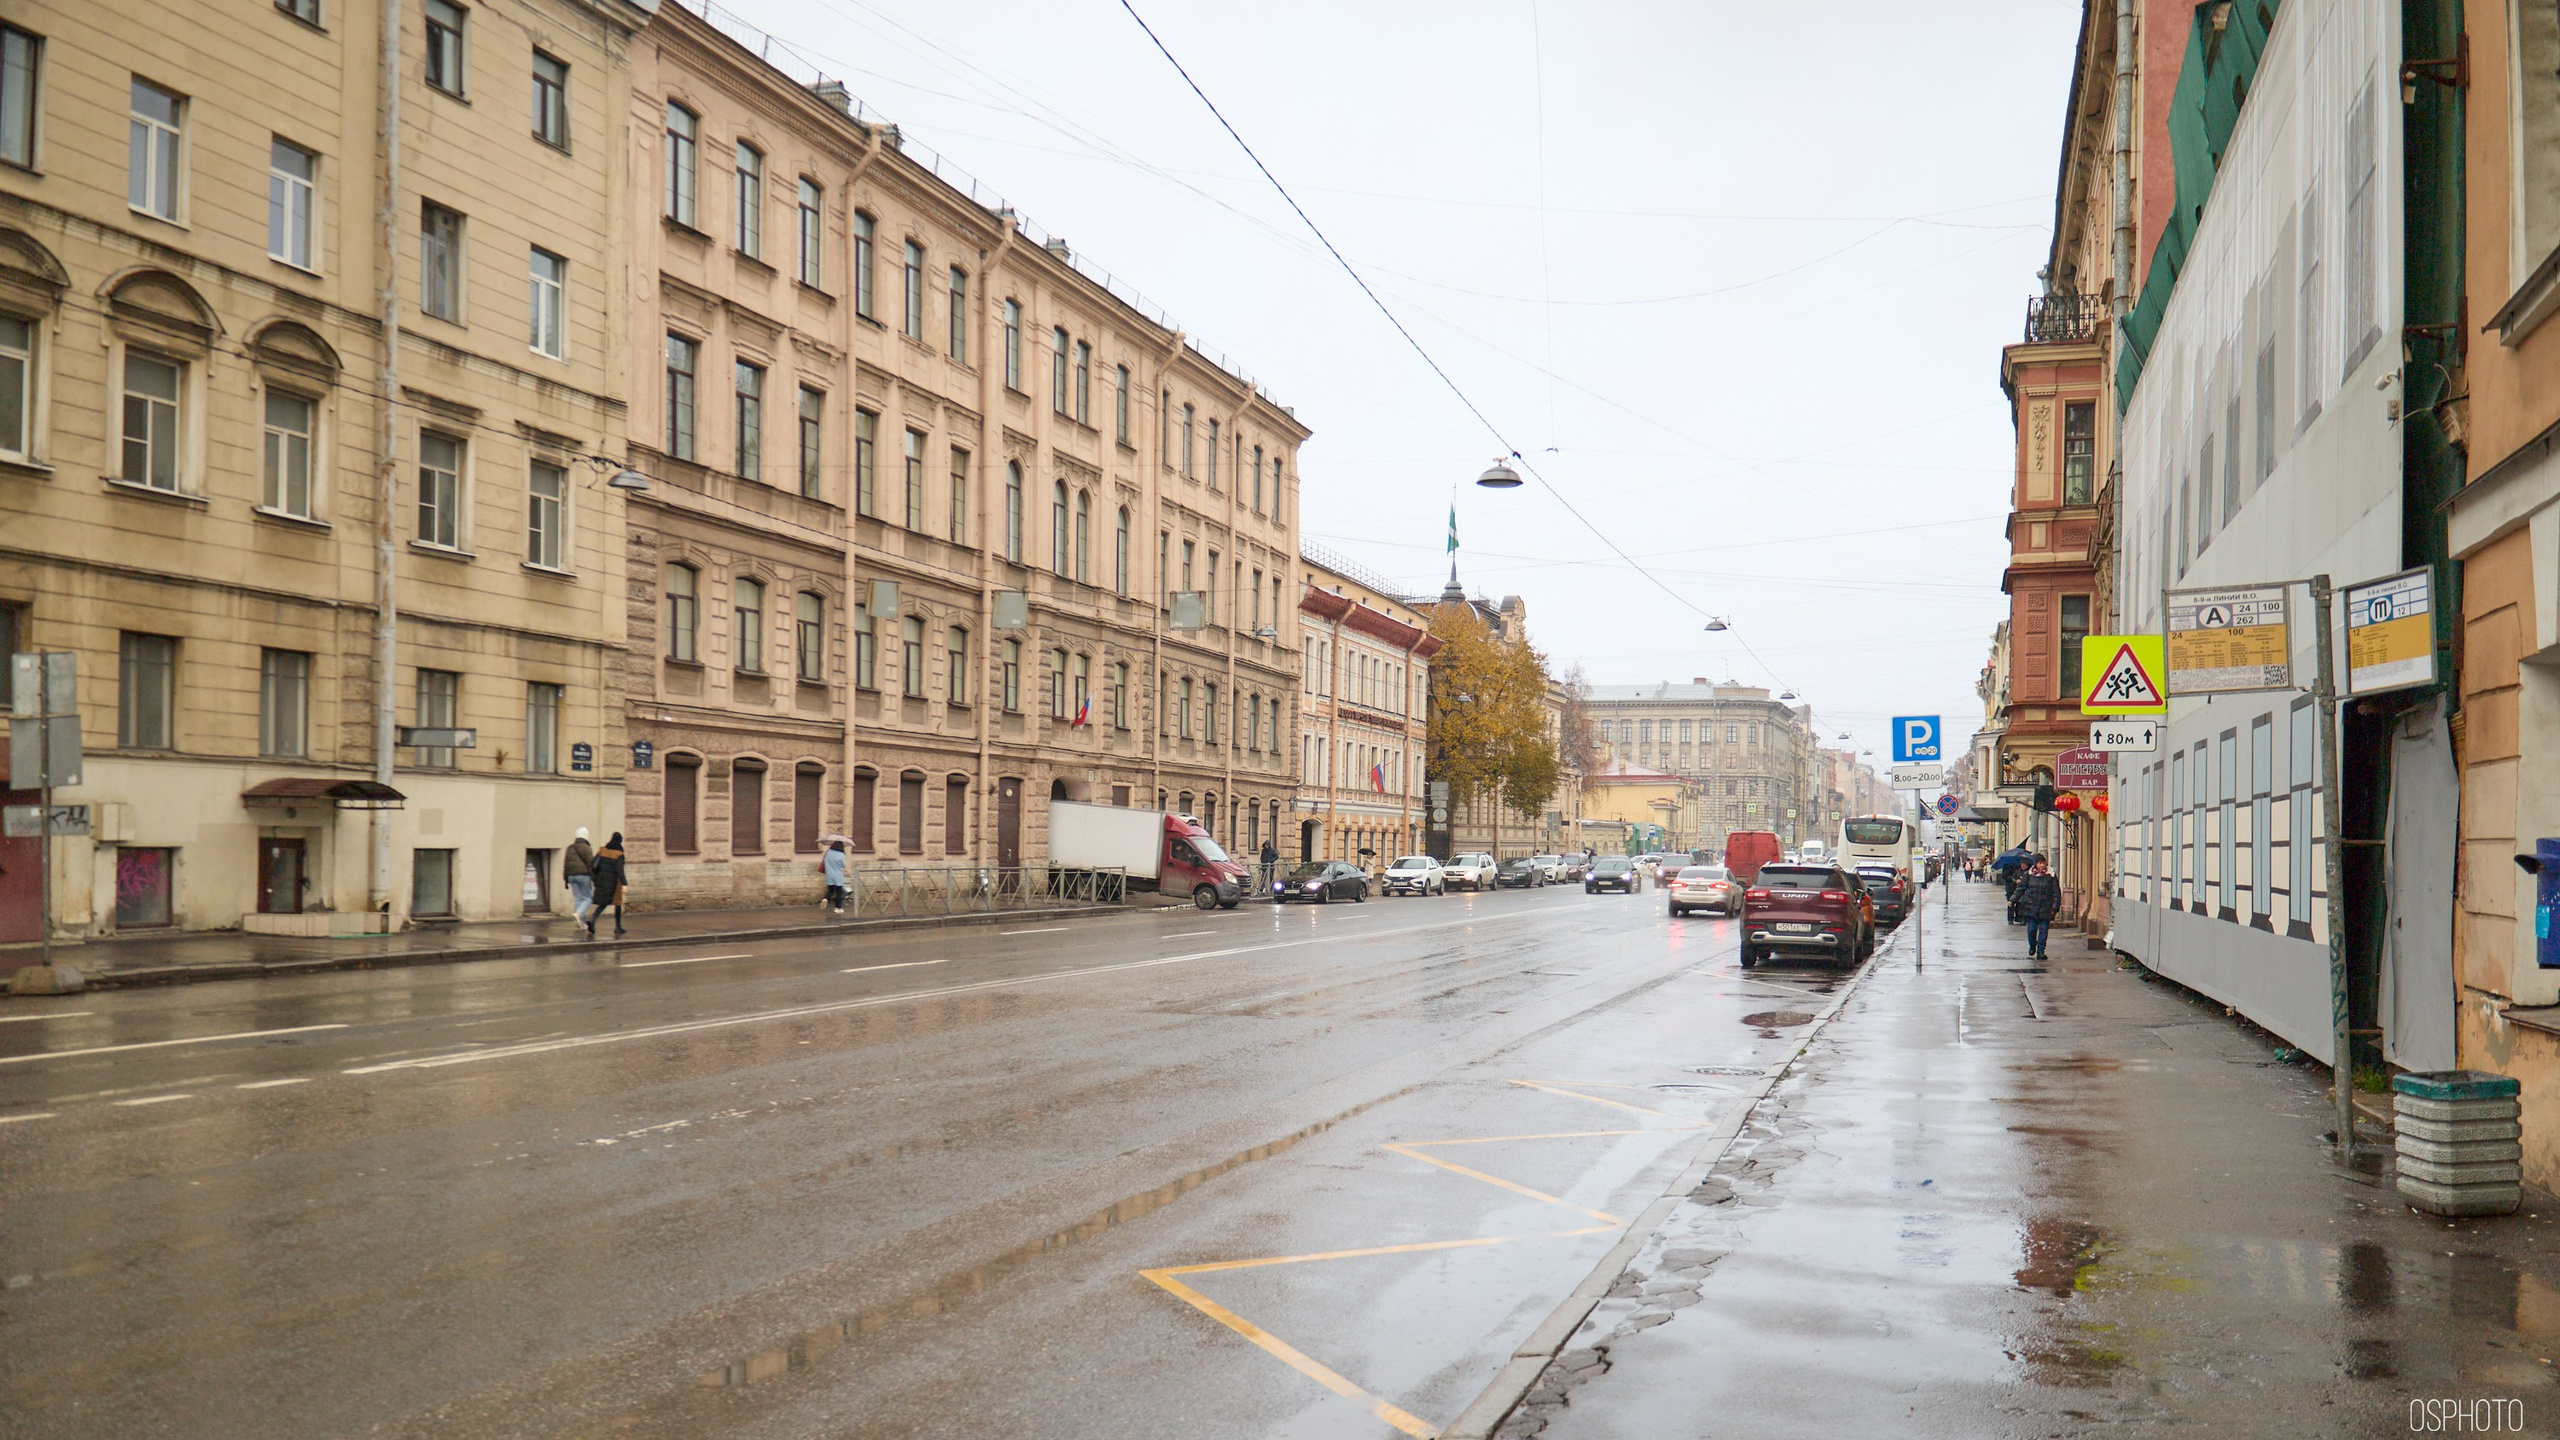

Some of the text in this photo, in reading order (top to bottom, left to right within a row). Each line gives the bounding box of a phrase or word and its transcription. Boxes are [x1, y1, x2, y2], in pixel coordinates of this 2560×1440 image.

[2213, 594, 2241, 602] ЛИНИИ
[2239, 604, 2251, 613] 24
[2262, 602, 2280, 611] 100
[2397, 606, 2406, 616] 12
[2236, 616, 2254, 625] 262
[2172, 632, 2183, 640] 24
[2228, 628, 2244, 636] 100
[2352, 628, 2361, 637] 12
[1905, 720, 1933, 757] P
[2107, 733, 2134, 745] 80м
[2077, 752, 2101, 760] КАФЕ
[2060, 763, 2108, 775] ПЕТЕРБУ
